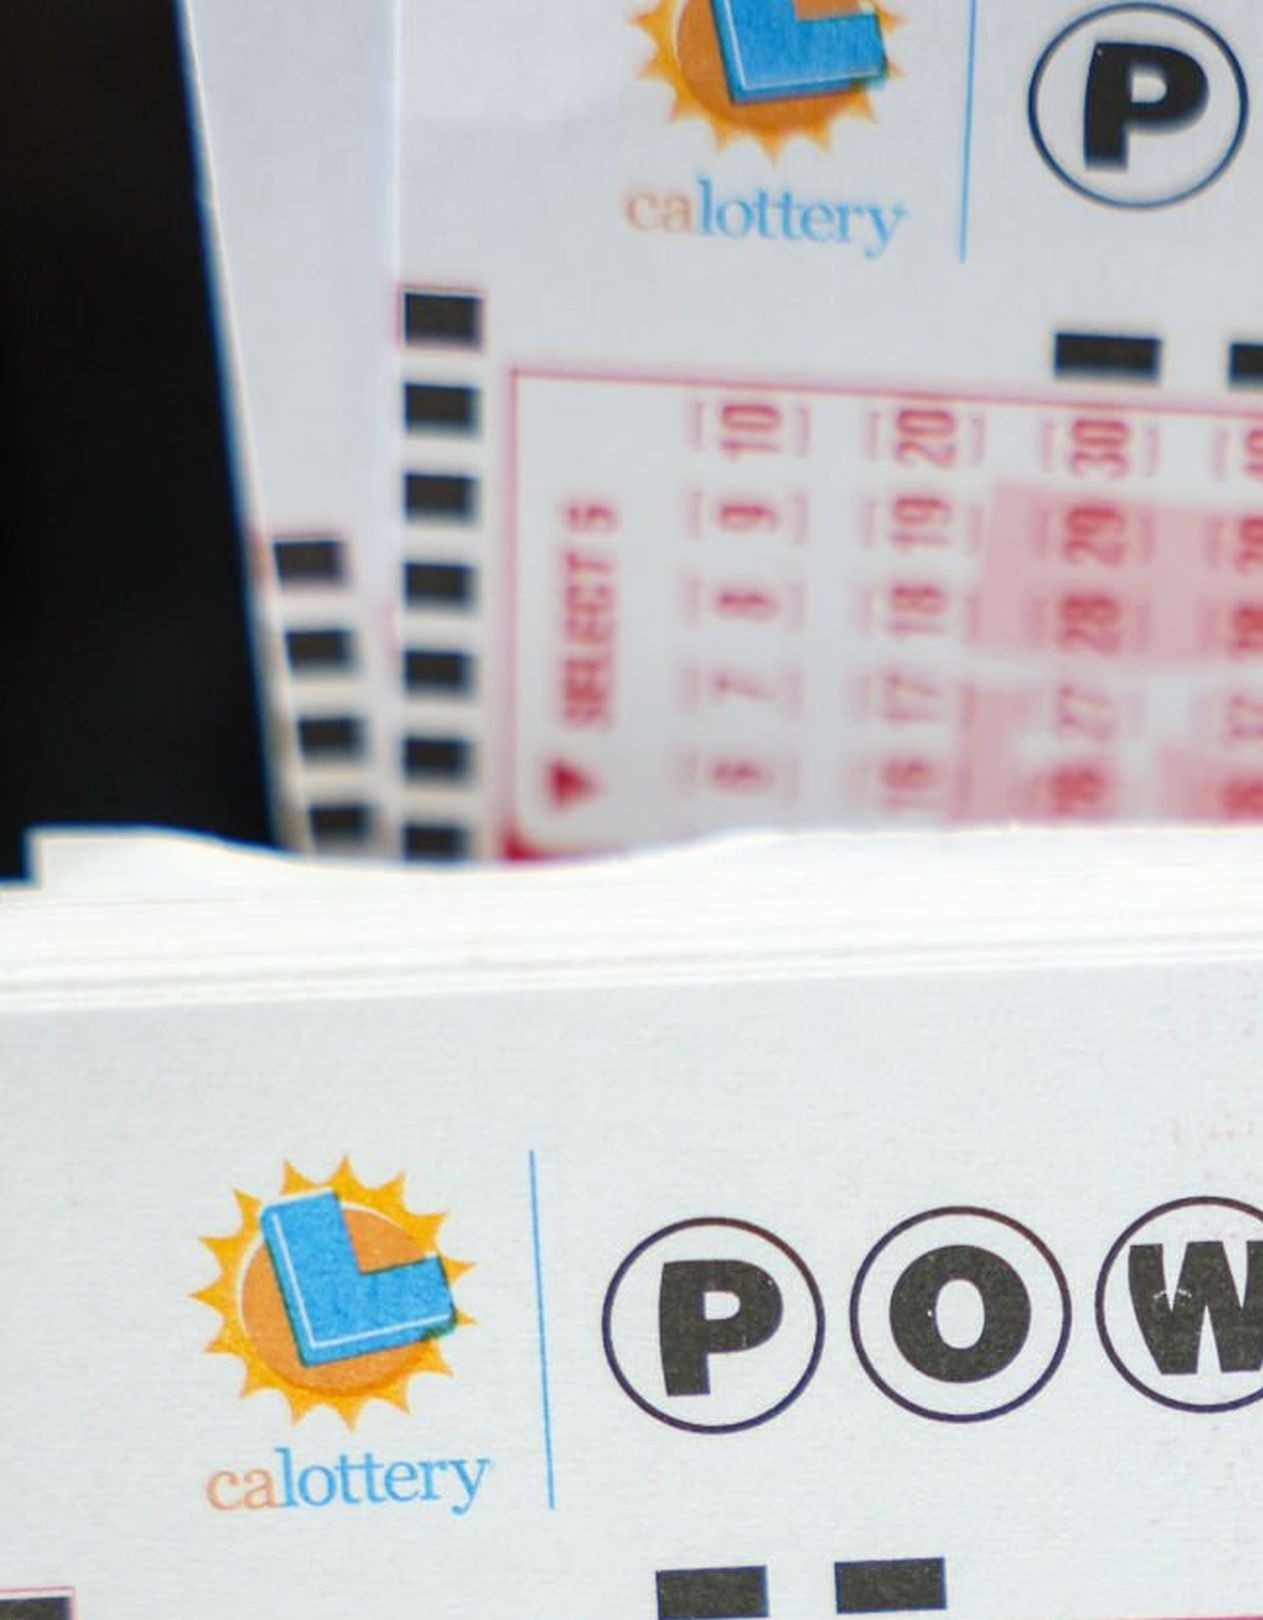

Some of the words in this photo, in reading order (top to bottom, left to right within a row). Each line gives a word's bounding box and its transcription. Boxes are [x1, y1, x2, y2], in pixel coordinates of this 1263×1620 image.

[622, 176, 906, 260] calottery
[719, 402, 781, 459] 10
[896, 408, 956, 468] 20
[1071, 419, 1126, 477] 30
[565, 501, 614, 532] 5
[712, 501, 779, 530] 9
[892, 494, 948, 549] 19
[1066, 503, 1123, 566] 29
[888, 582, 945, 635] 18
[1060, 593, 1121, 654] 28
[560, 551, 612, 727] SELECT
[205, 1447, 491, 1517] calottery
